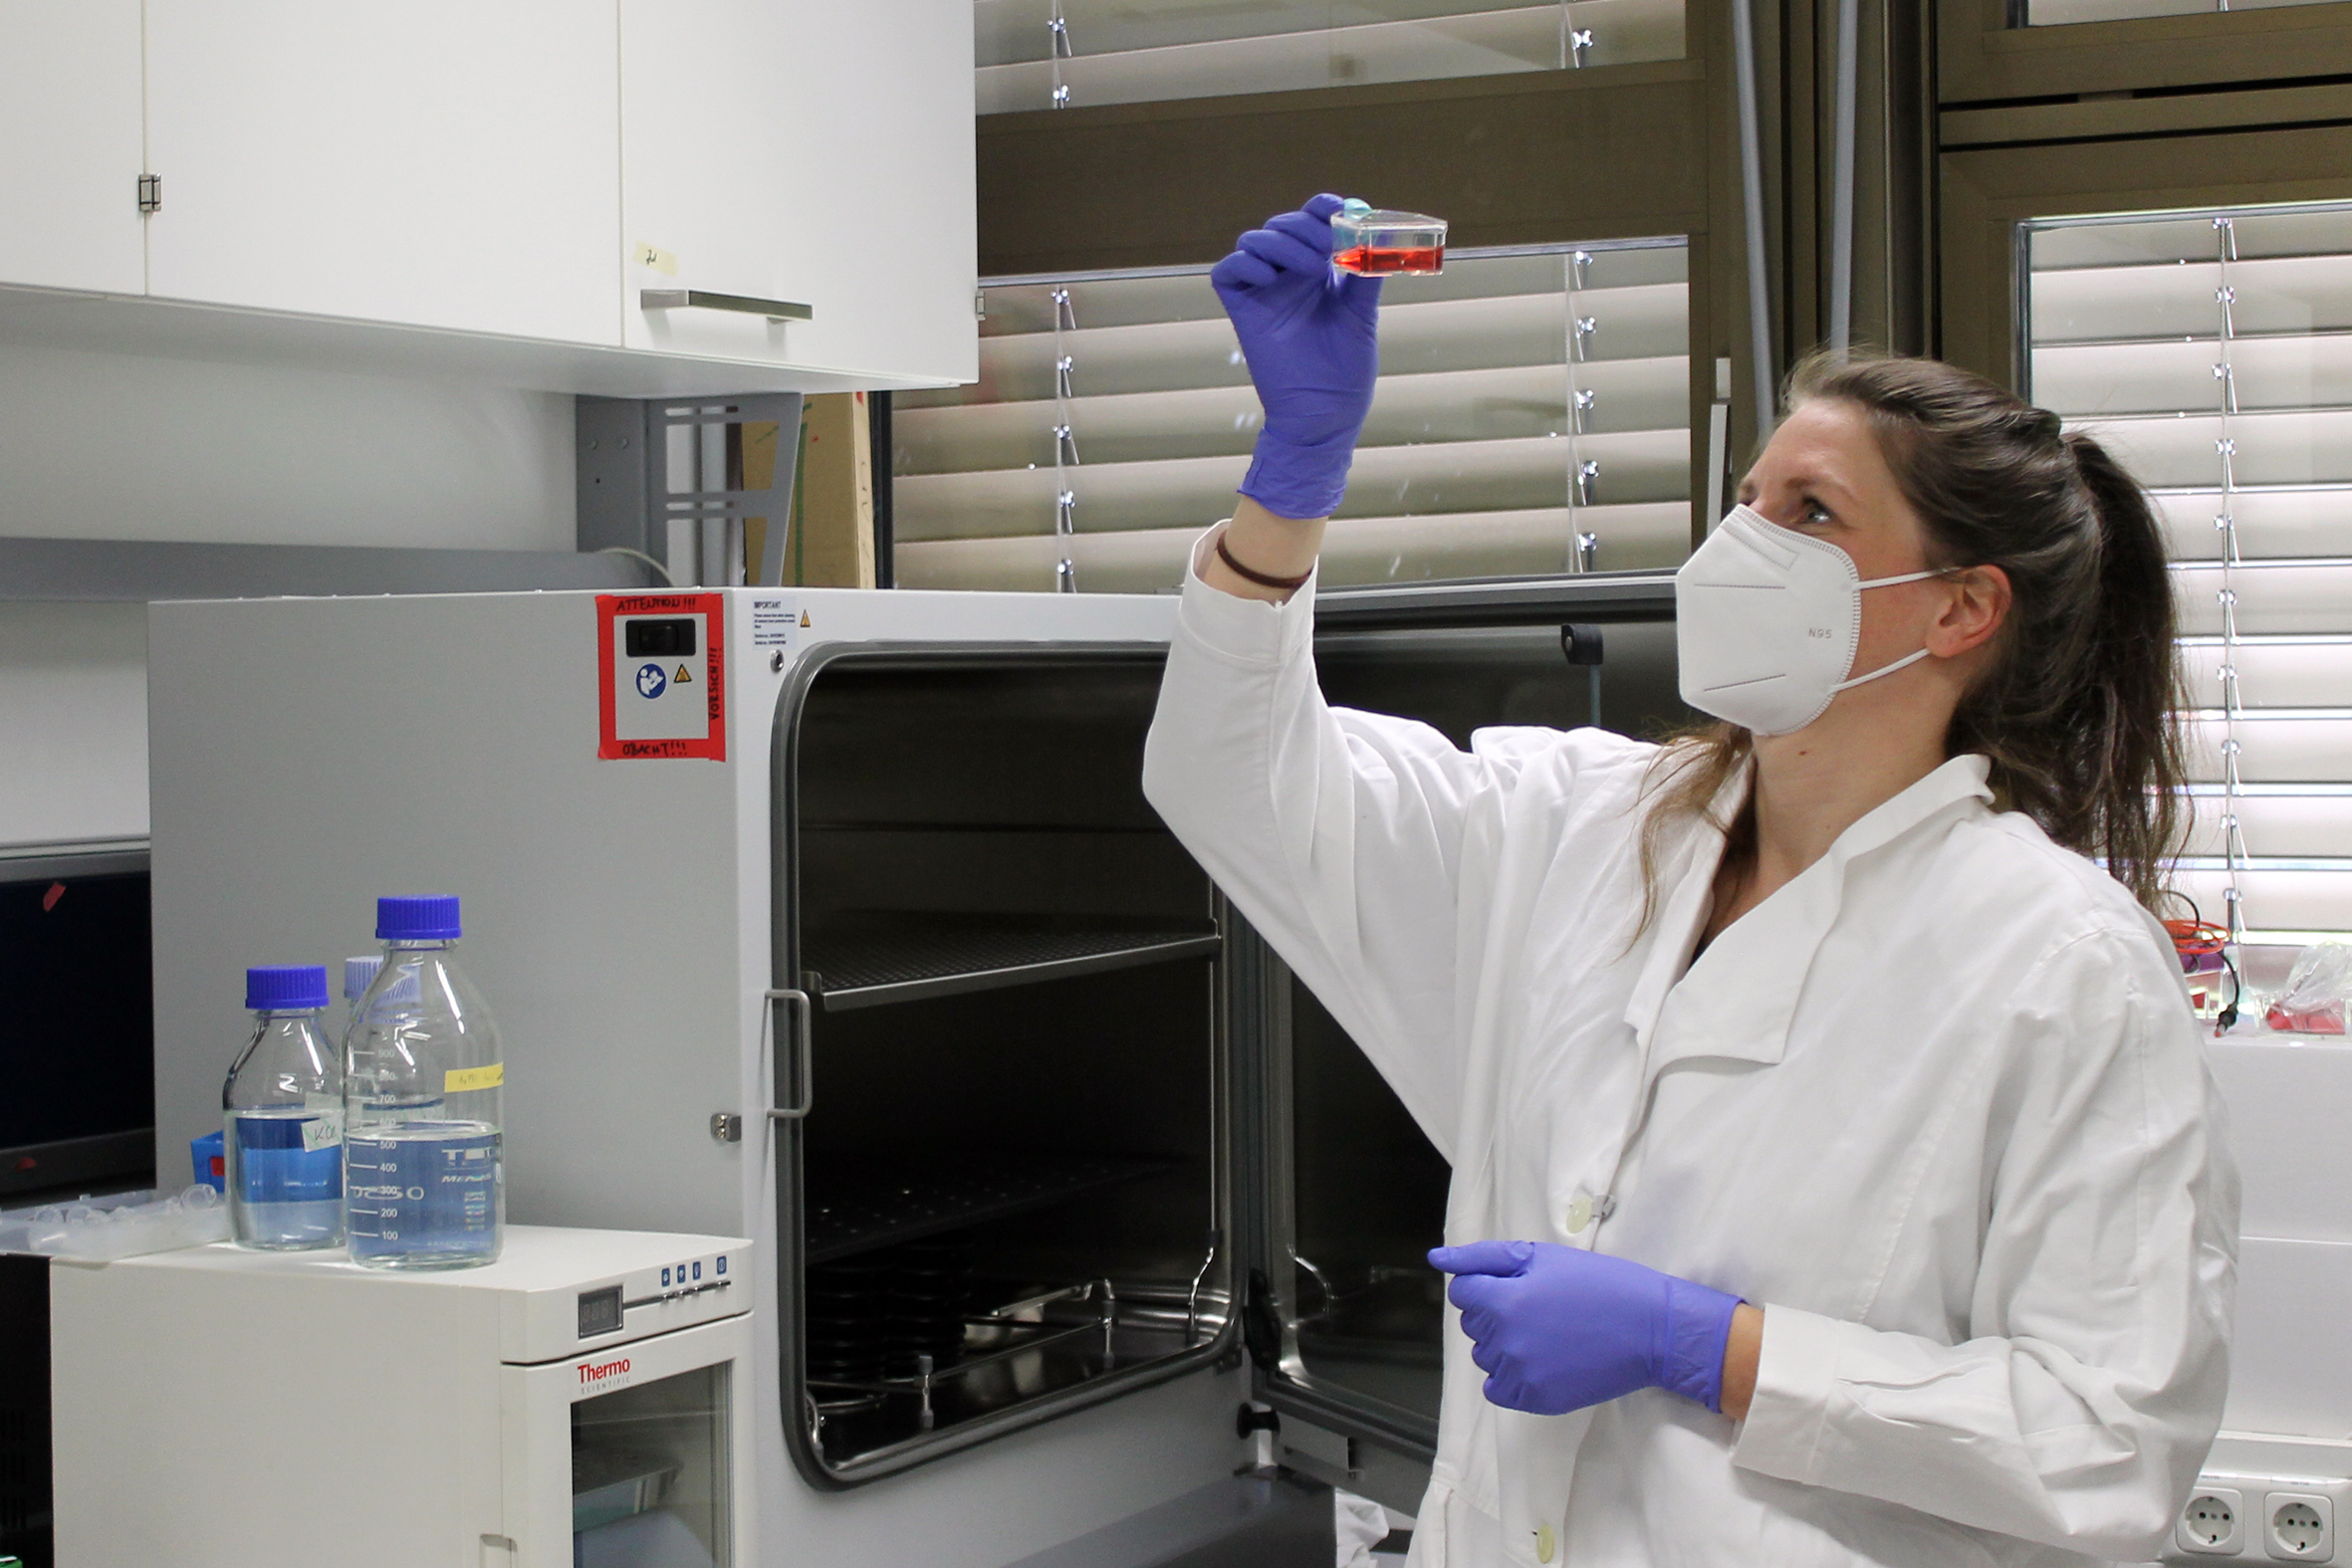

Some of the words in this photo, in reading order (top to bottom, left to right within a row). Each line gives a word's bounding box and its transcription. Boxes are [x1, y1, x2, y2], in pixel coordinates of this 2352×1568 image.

[1808, 628, 1832, 639] N95
[379, 1094, 396, 1104] 700
[380, 1140, 397, 1150] 500
[380, 1163, 397, 1173] 400
[380, 1185, 397, 1196] 300
[380, 1208, 398, 1219] 200
[382, 1231, 398, 1240] 100
[578, 1359, 630, 1384] Thermo
[581, 1376, 630, 1395] SCIENTIFIC
